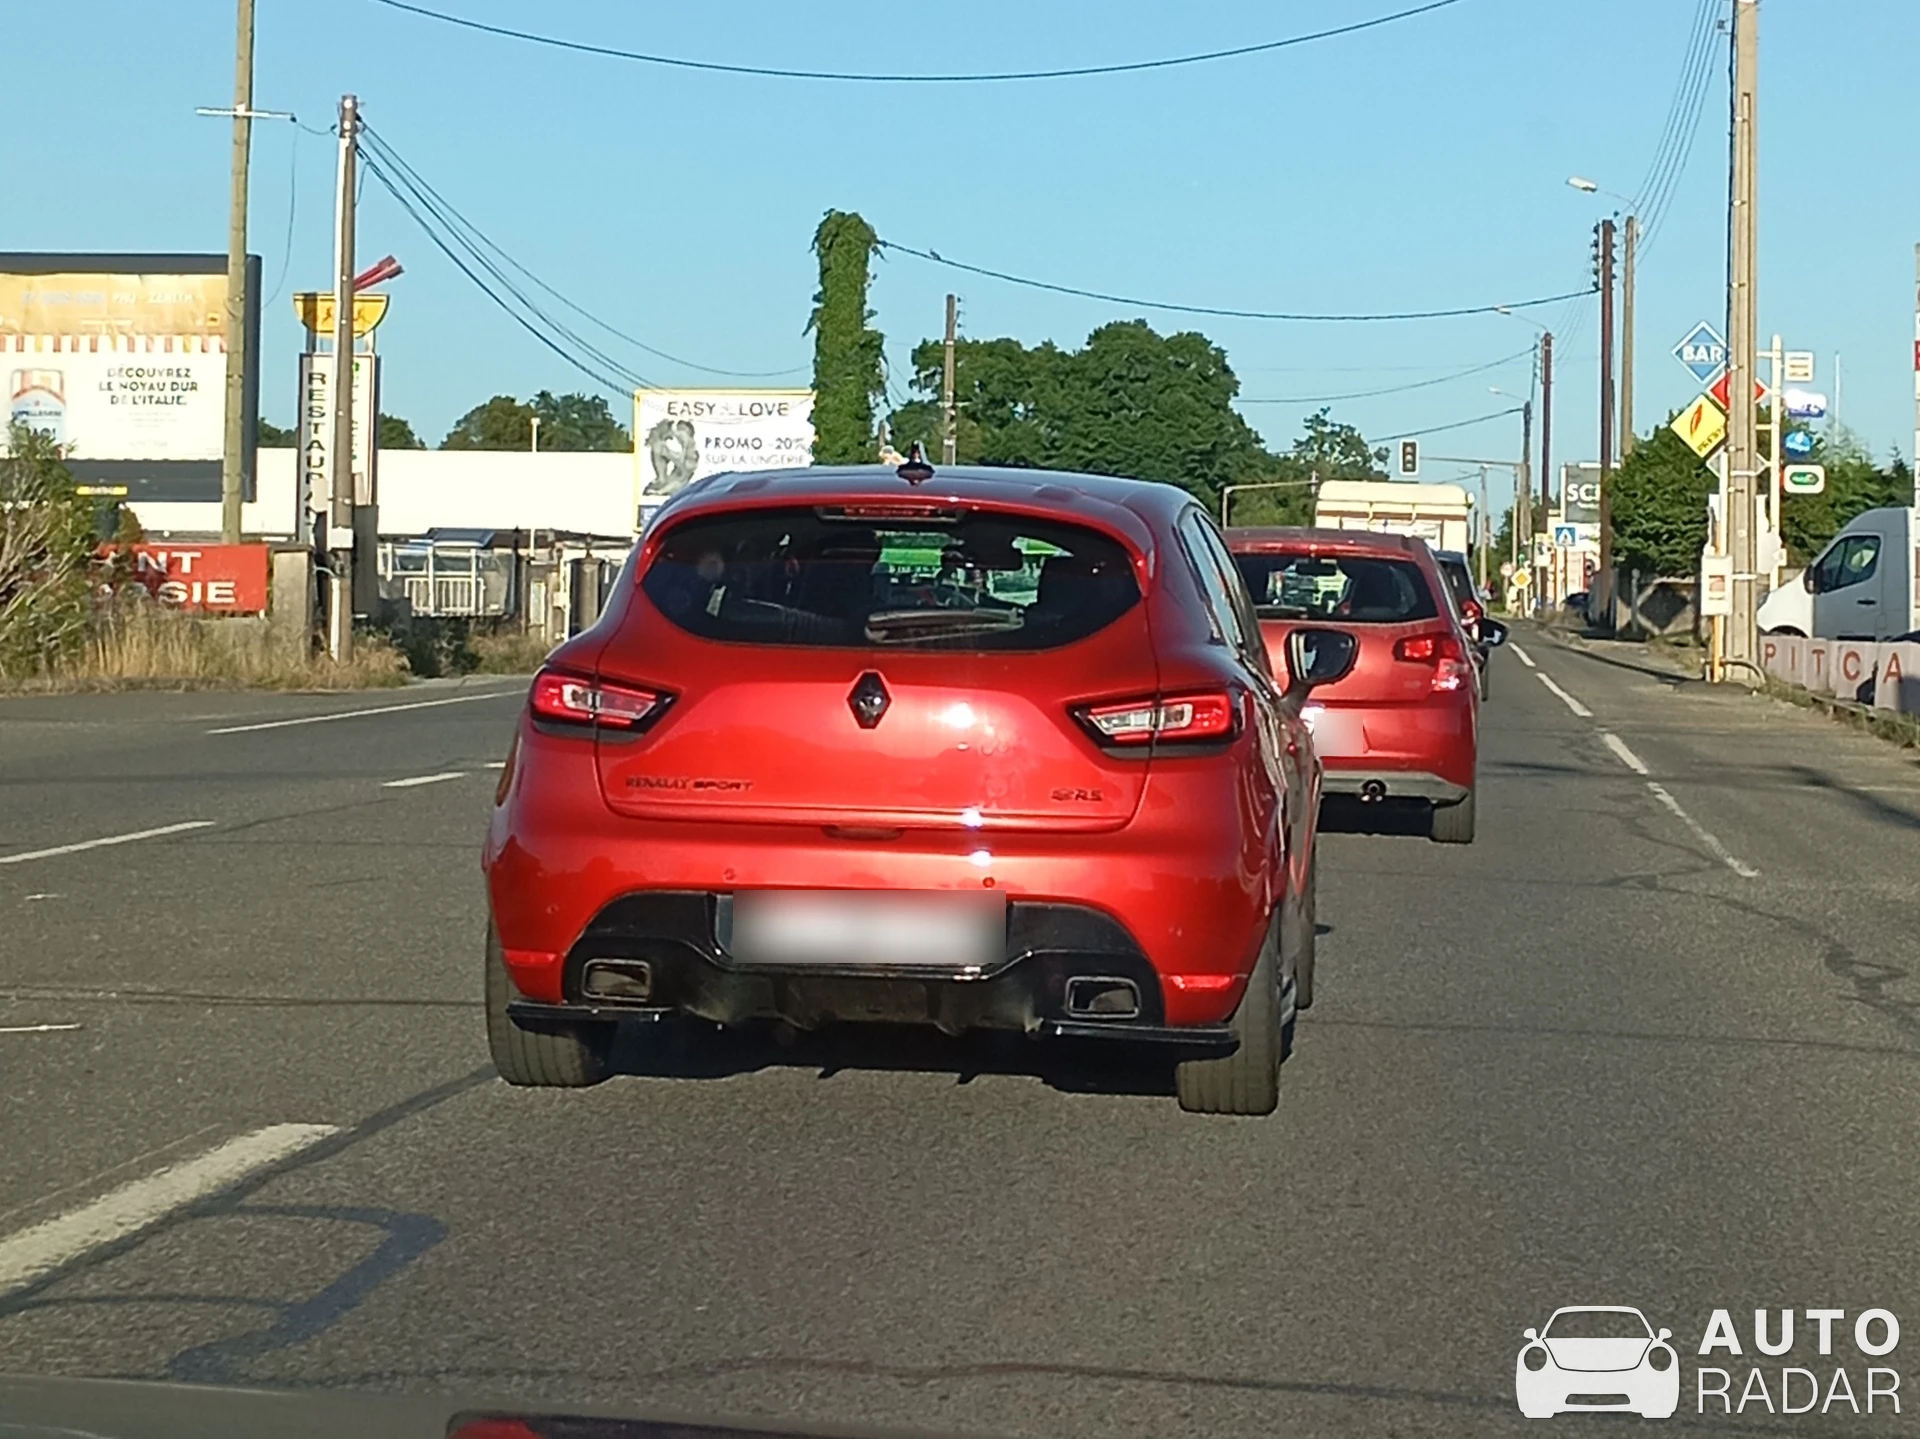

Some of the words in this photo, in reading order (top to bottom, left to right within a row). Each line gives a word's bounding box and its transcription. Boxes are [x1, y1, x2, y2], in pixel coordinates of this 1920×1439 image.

[1682, 344, 1723, 362] BAR
[99, 381, 114, 392] LE
[119, 381, 167, 392] NOYAU
[170, 381, 199, 392] DUR
[110, 395, 128, 405] DE
[667, 401, 716, 417] EASY
[739, 402, 790, 417] LOVE
[705, 437, 763, 451] PROMO
[705, 455, 727, 466] SUR
[732, 455, 746, 466] LA
[693, 780, 755, 791] SPORT
